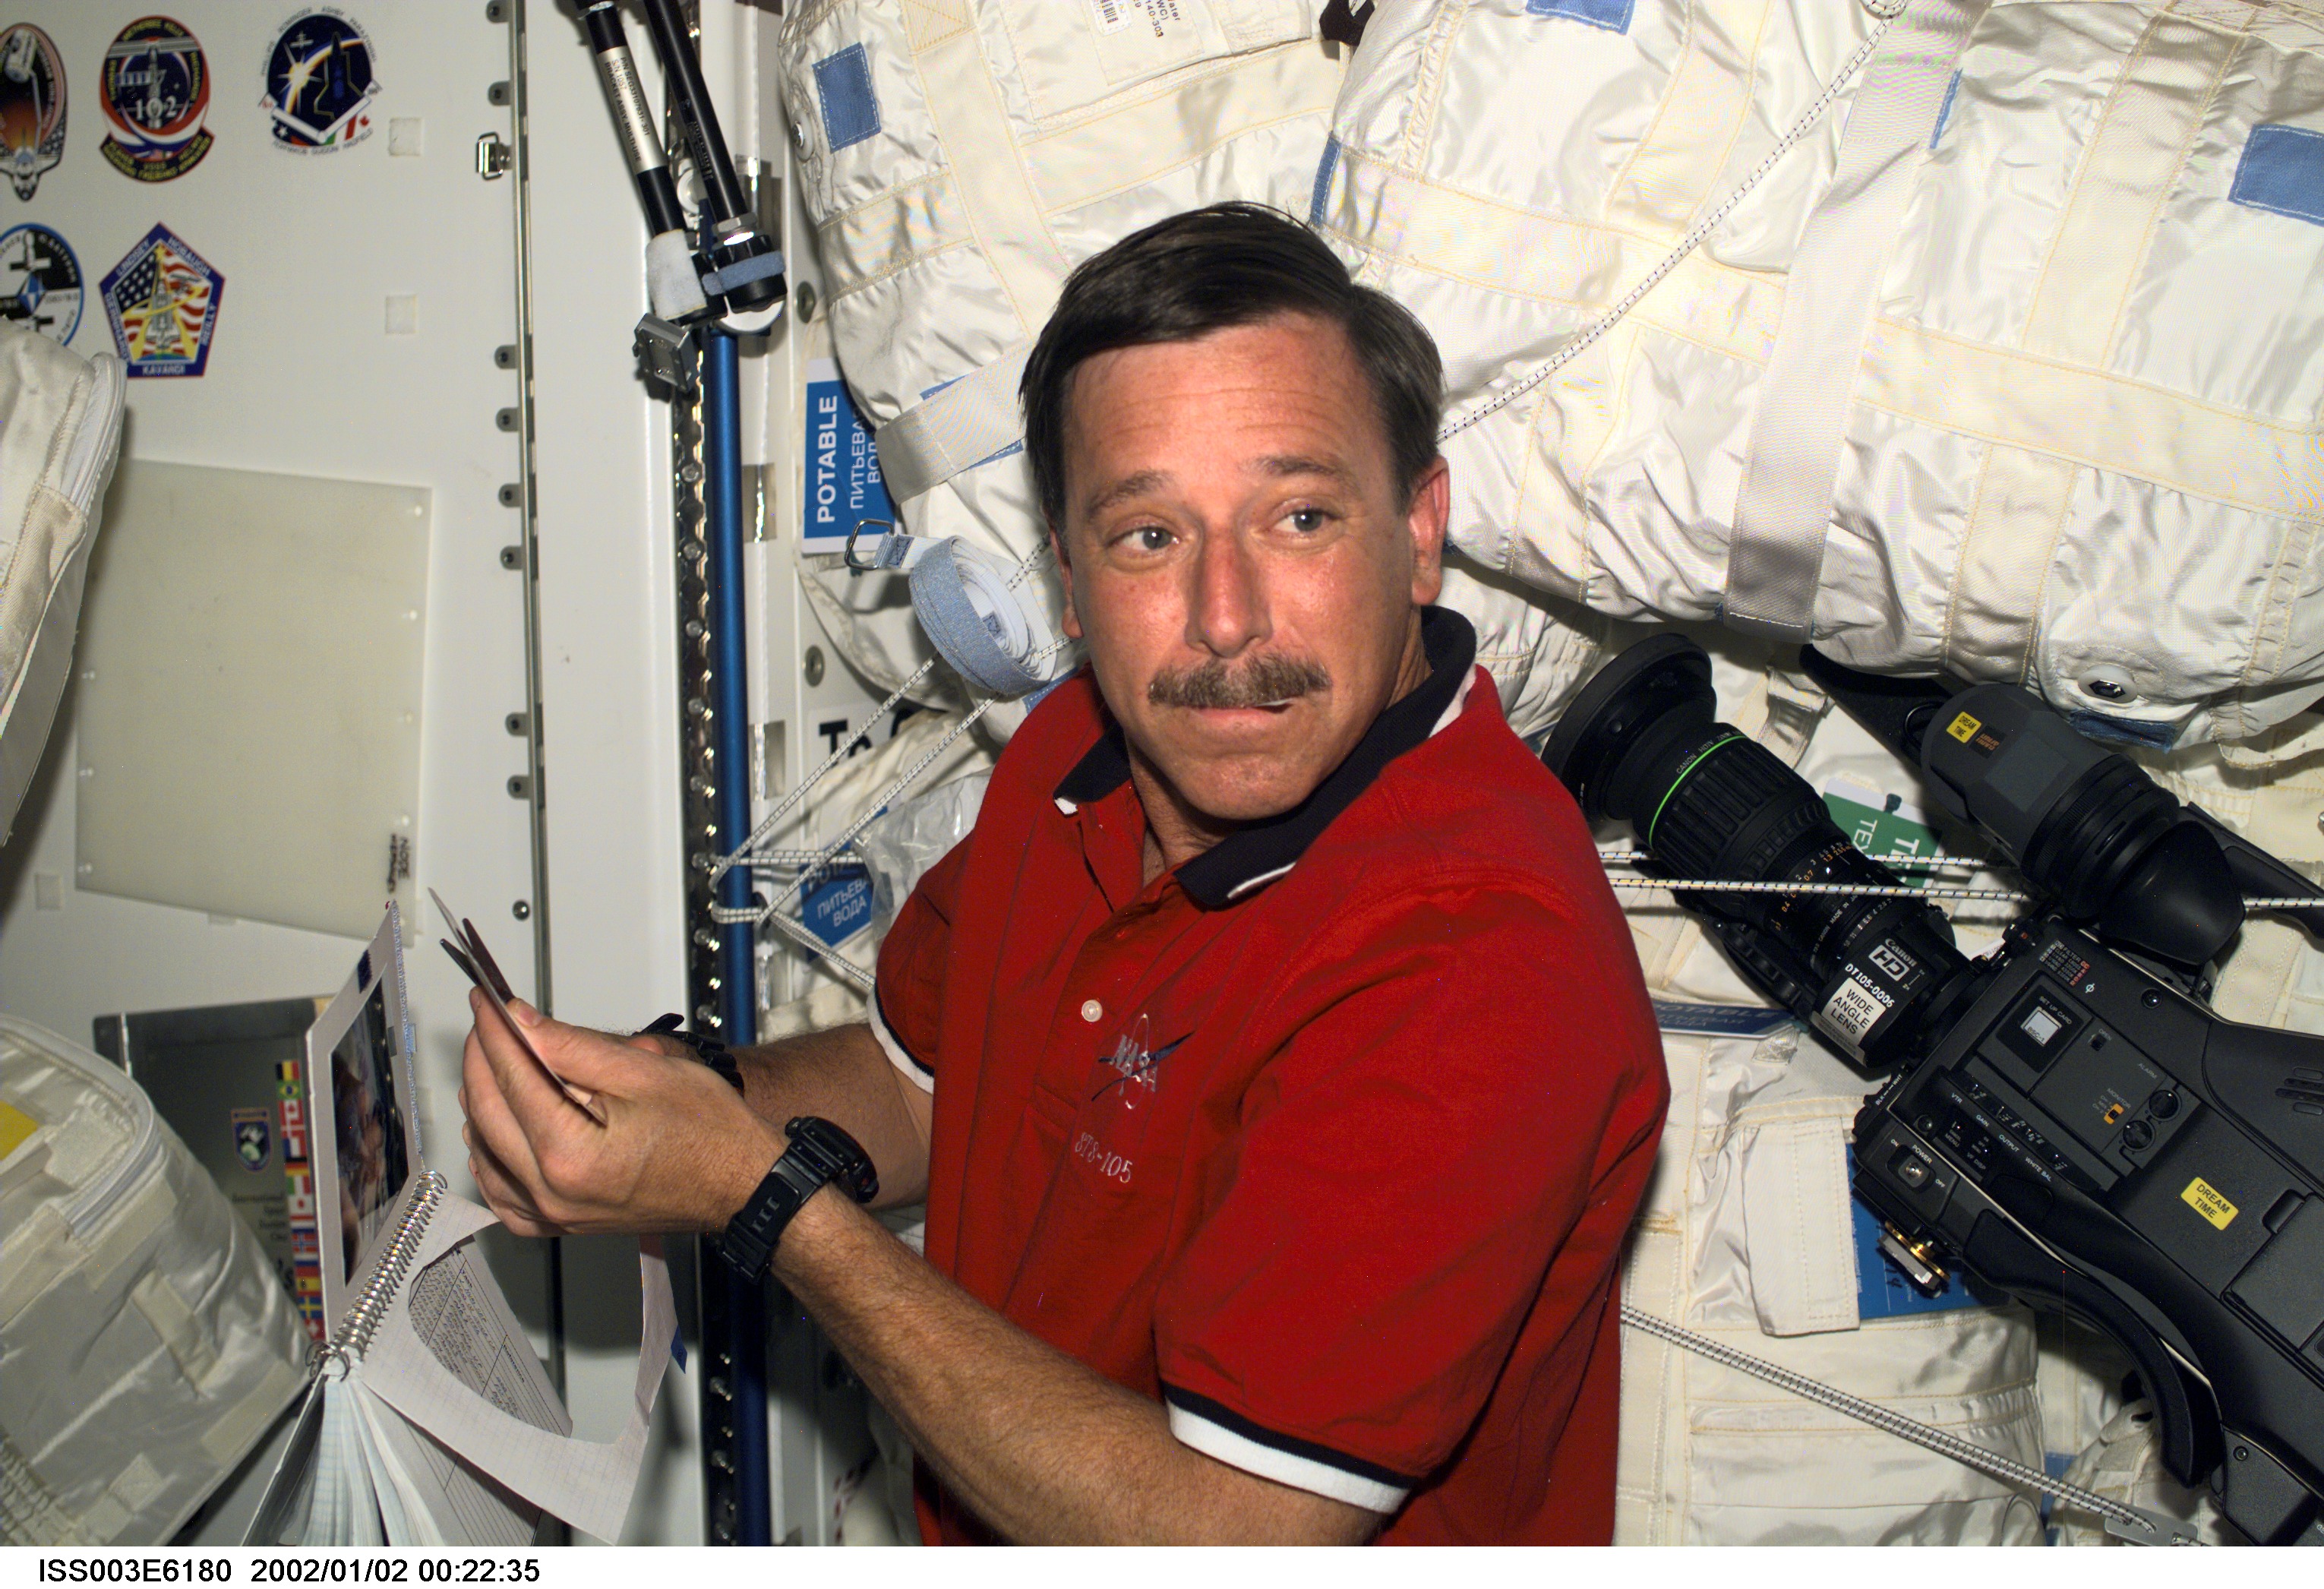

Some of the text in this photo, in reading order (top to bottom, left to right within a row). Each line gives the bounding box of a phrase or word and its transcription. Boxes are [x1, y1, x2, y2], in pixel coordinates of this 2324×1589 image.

[605, 62, 620, 99] BRACKET
[134, 95, 177, 122] 102
[817, 396, 838, 523] POTABLE
[1954, 725, 1966, 737] TIME
[1959, 716, 1976, 730] DREAM
[1676, 753, 1697, 774] CANON
[832, 895, 867, 927] ВОДА
[1872, 949, 1905, 976] HD
[1885, 938, 1918, 967] Canon
[1833, 997, 1870, 1029] ANGLE
[1846, 988, 1874, 1016] WIDE
[2039, 996, 2072, 1025] SET UP CARD
[1830, 1008, 1858, 1034] LENS
[2098, 1028, 2112, 1041] OPEN
[2138, 1063, 2157, 1079] ALARM
[1951, 1092, 1963, 1104] VTR
[2107, 1088, 2131, 1109] MONITOR
[1976, 1114, 1989, 1126] GAIN
[1891, 1139, 1899, 1147] ON
[1912, 1144, 1933, 1164] POWER
[1999, 1134, 2019, 1152] OUTPUT
[1075, 1132, 1134, 1183] STS-105
[2026, 1156, 2042, 1173] WHITE
[2041, 1170, 2051, 1182] BAL
[1935, 1179, 1946, 1188] OFF
[2195, 1196, 2218, 1218] TIME
[2196, 1183, 2231, 1214] DREAM
